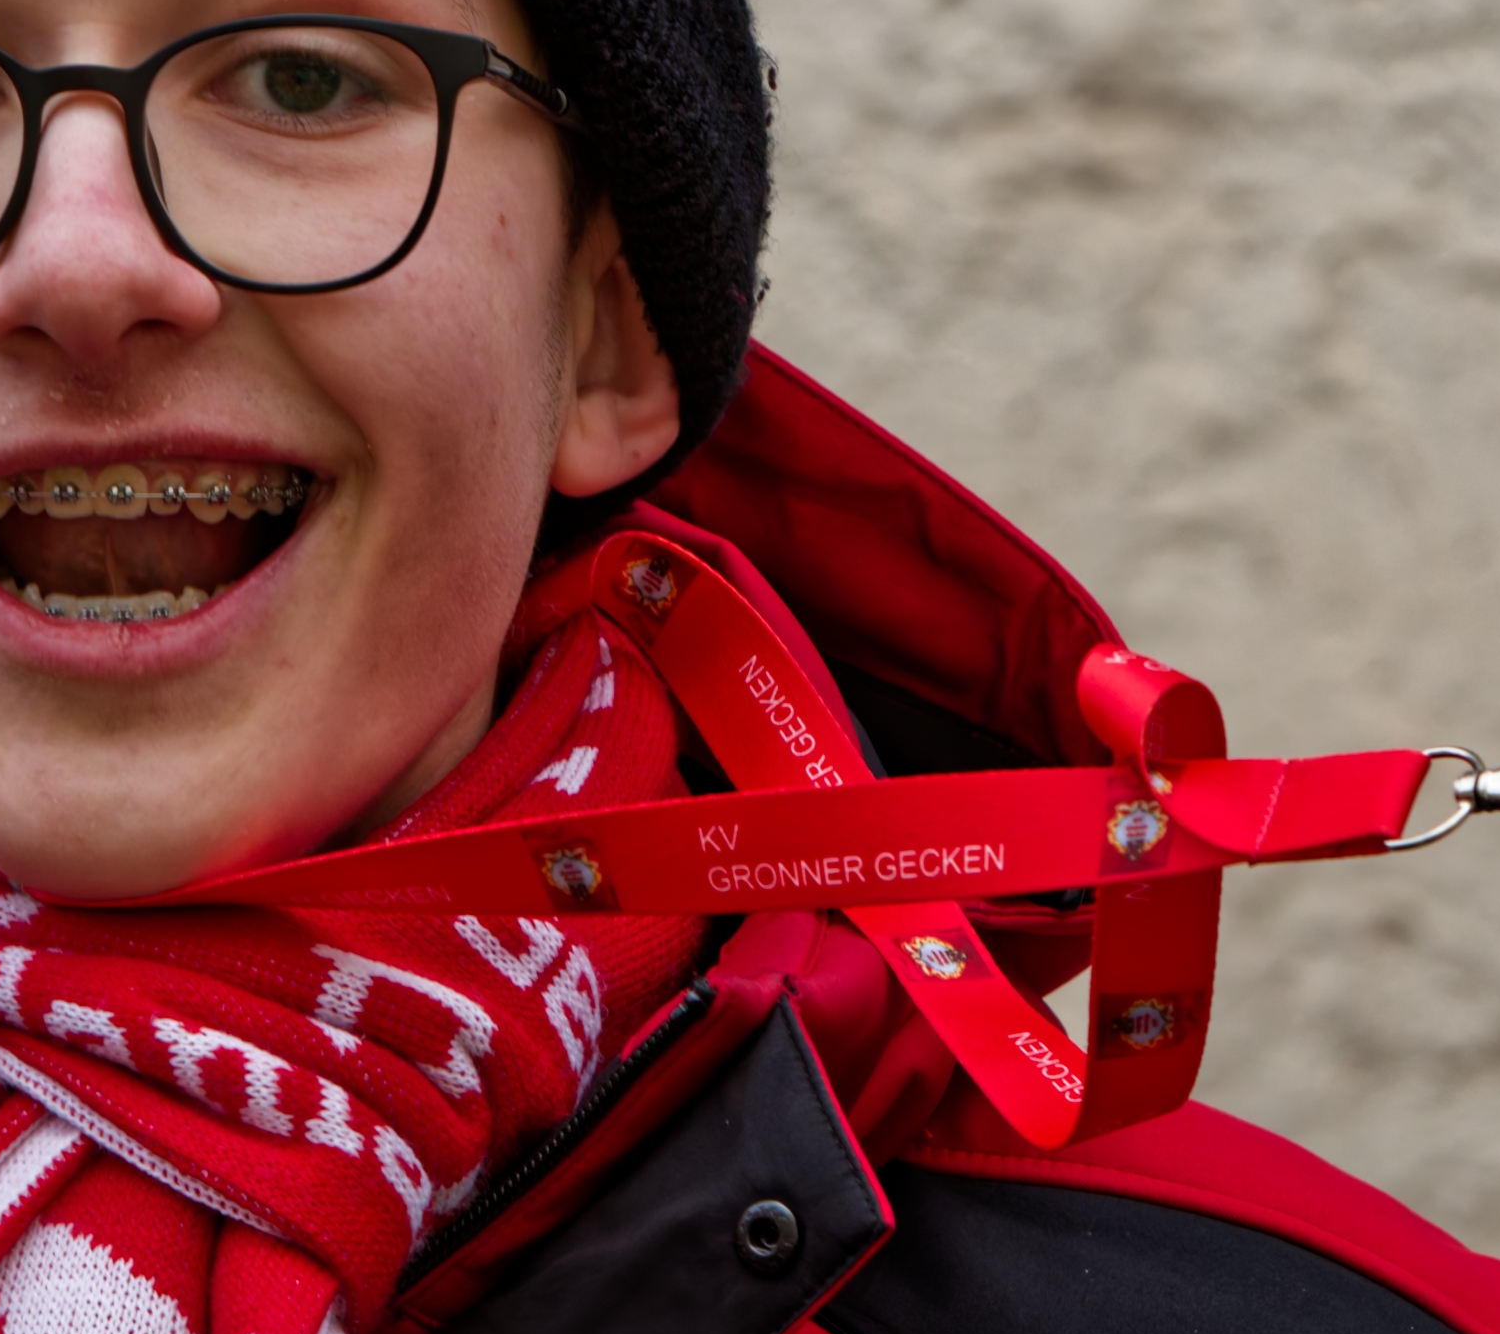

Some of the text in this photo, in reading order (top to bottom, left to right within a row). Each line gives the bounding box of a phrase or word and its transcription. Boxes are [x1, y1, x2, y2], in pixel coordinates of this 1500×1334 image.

[740, 655, 816, 760] GECKEN
[698, 824, 740, 852] KV
[707, 843, 1005, 893] GRONNER GECKEN
